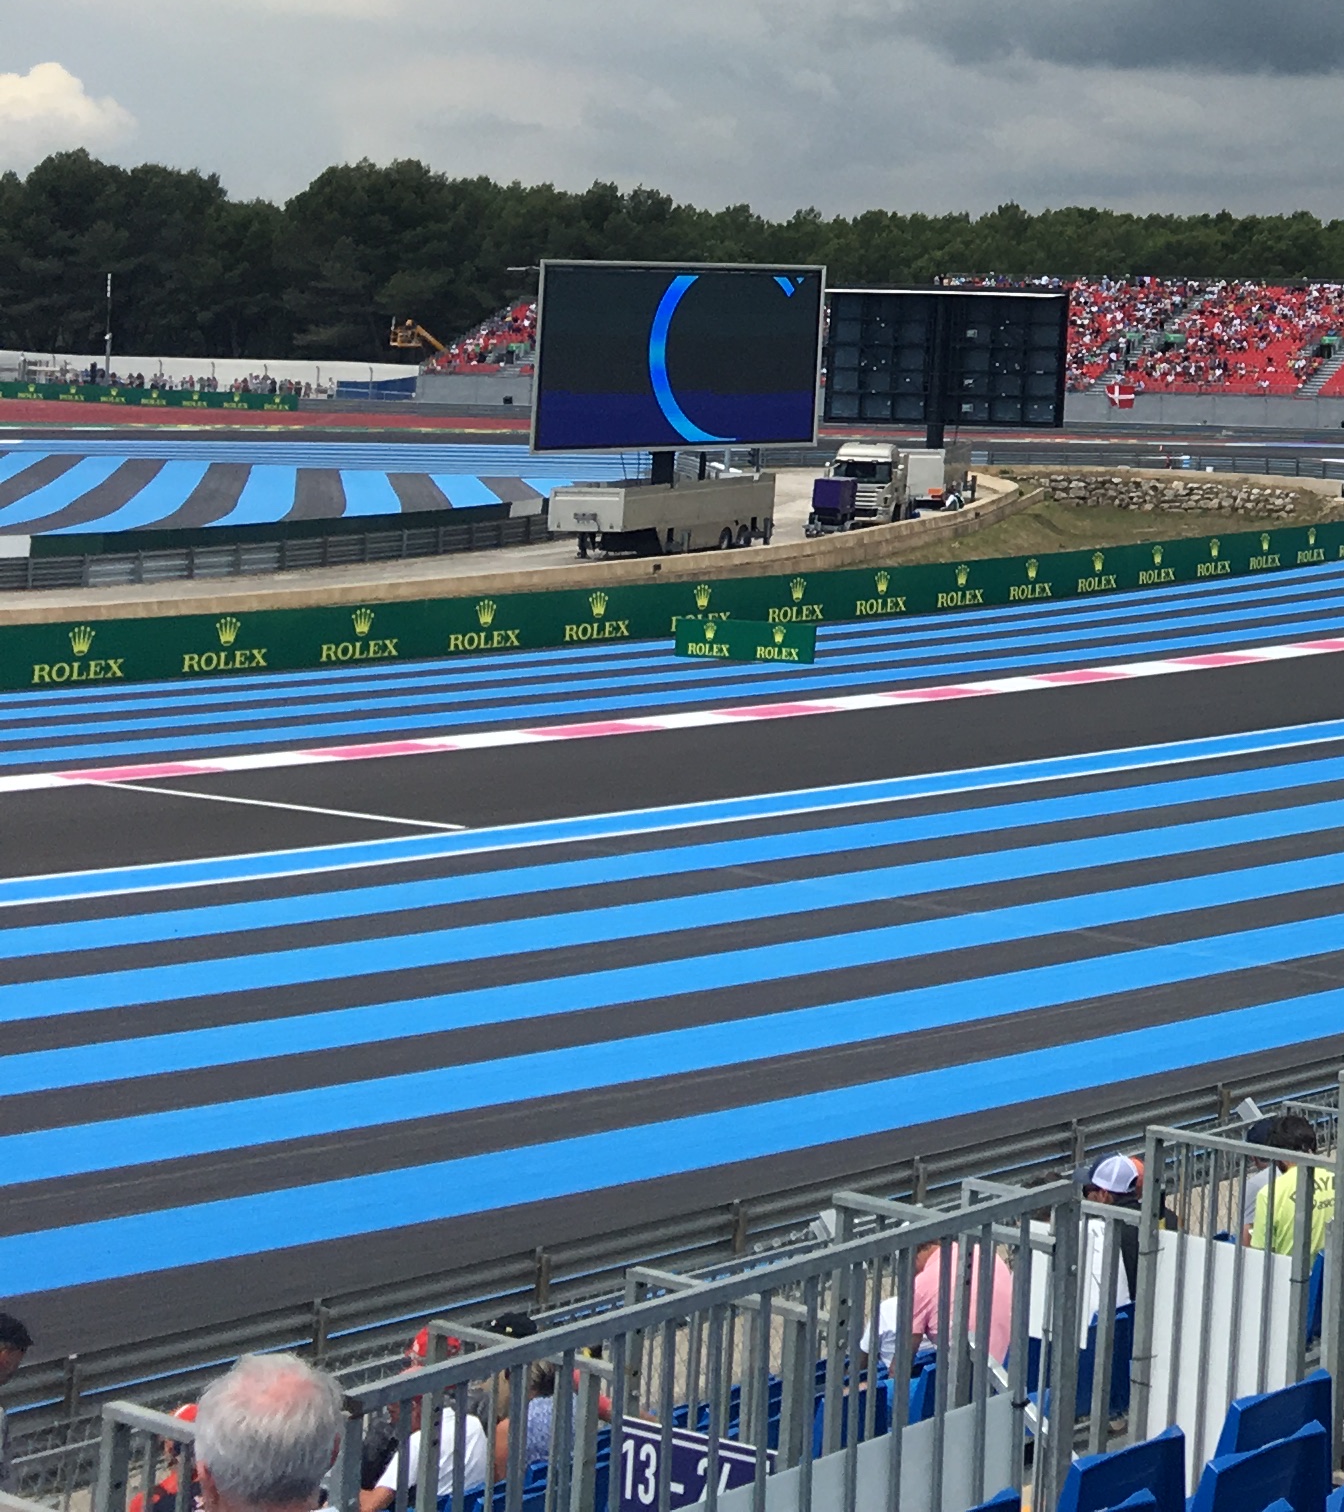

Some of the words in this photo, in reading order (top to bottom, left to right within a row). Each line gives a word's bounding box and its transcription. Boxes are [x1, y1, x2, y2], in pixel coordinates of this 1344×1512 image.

[32, 659, 124, 683] ROLEX
[182, 649, 267, 672] ROLEX
[320, 639, 398, 662] ROLEX
[448, 629, 520, 651] ROLEX
[563, 620, 630, 641] ROLEX
[768, 604, 823, 623] ROLEX
[856, 597, 906, 616] ROLEX
[937, 589, 984, 608] ROLEX
[1009, 582, 1052, 600] ROLEX
[1077, 575, 1117, 593] ROLEX
[1139, 568, 1175, 584] ROLEX
[1197, 561, 1230, 577] ROLEX
[1250, 554, 1281, 570] ROLEX
[1297, 548, 1325, 564] ROLEX
[687, 643, 729, 657] ROLEX
[756, 647, 799, 660] ROLEX
[622, 1439, 657, 1505] 13
